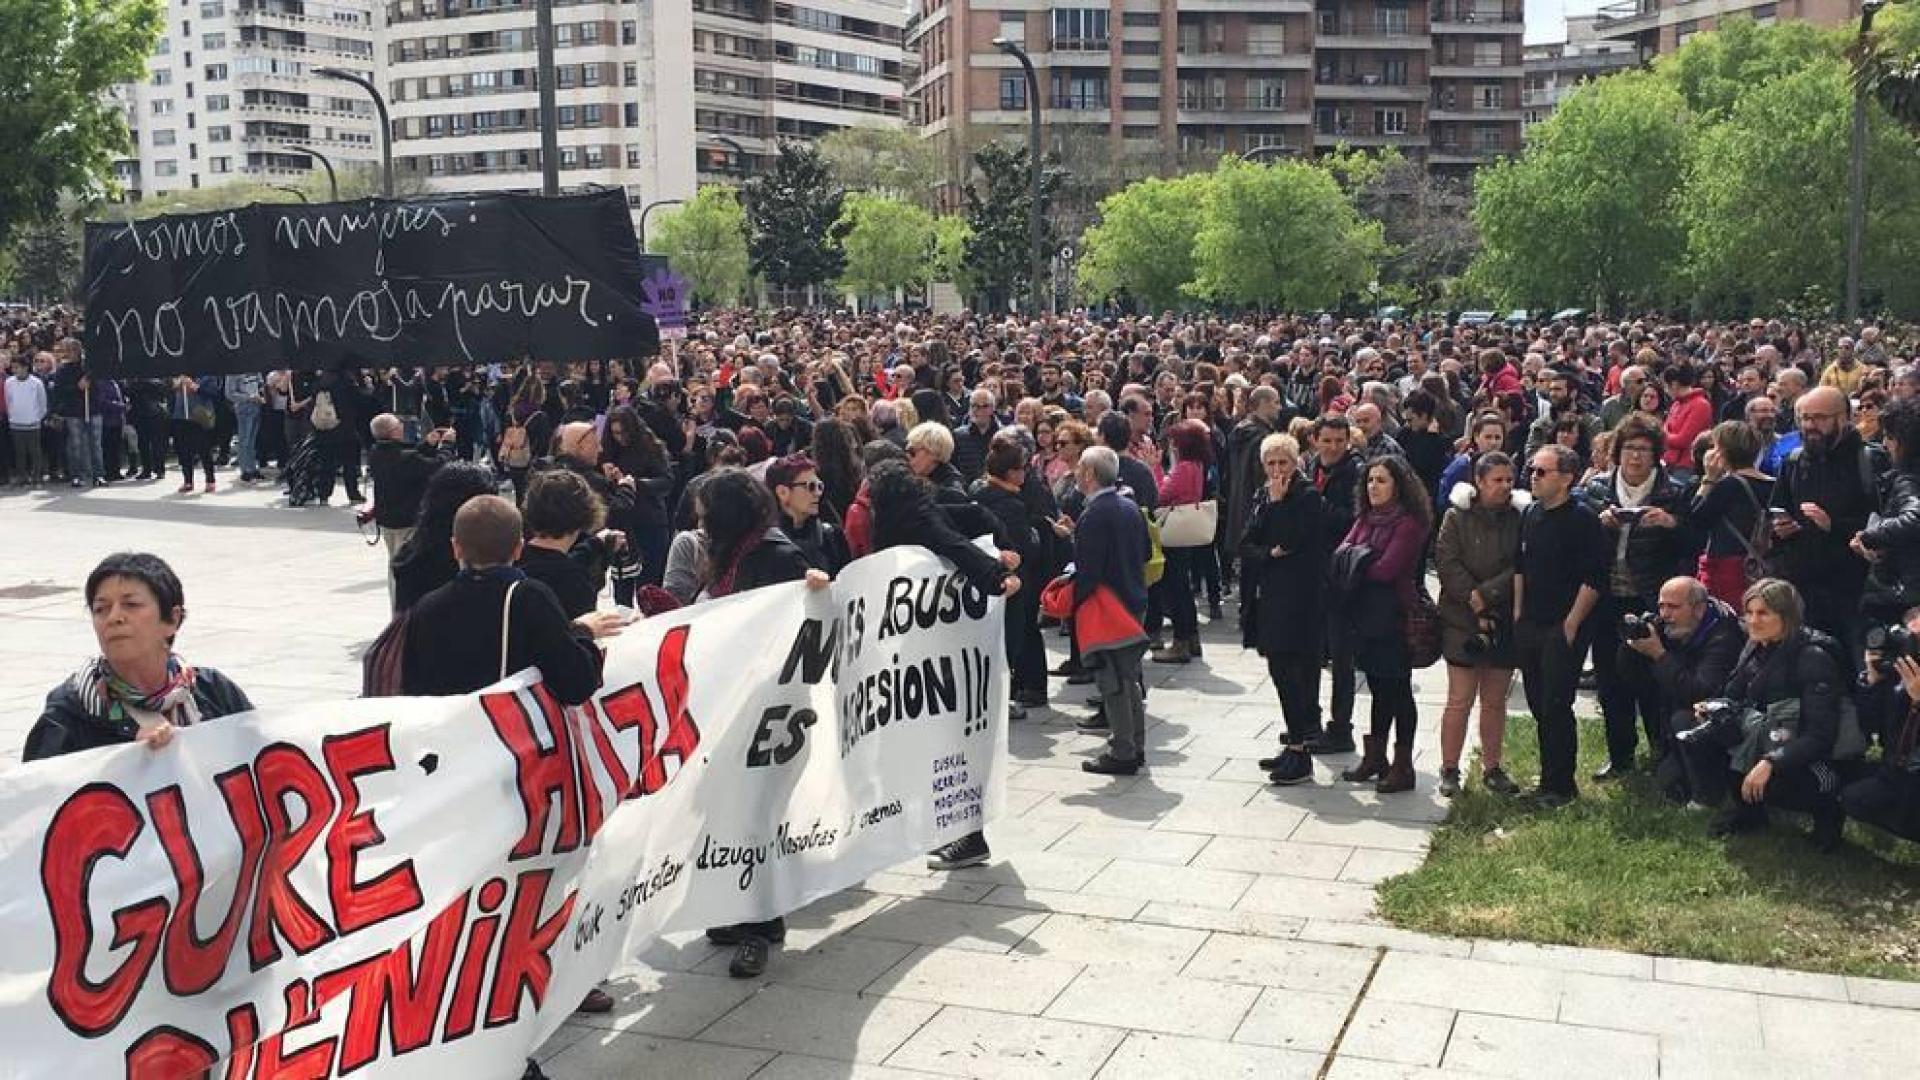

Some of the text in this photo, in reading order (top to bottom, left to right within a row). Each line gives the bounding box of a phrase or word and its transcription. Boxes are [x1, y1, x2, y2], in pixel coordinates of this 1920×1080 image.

[96, 296, 184, 363] no
[878, 570, 989, 641] ABUSO
[746, 703, 819, 769] ES
[40, 722, 425, 1039] GURE
[696, 834, 768, 891] dizugu
